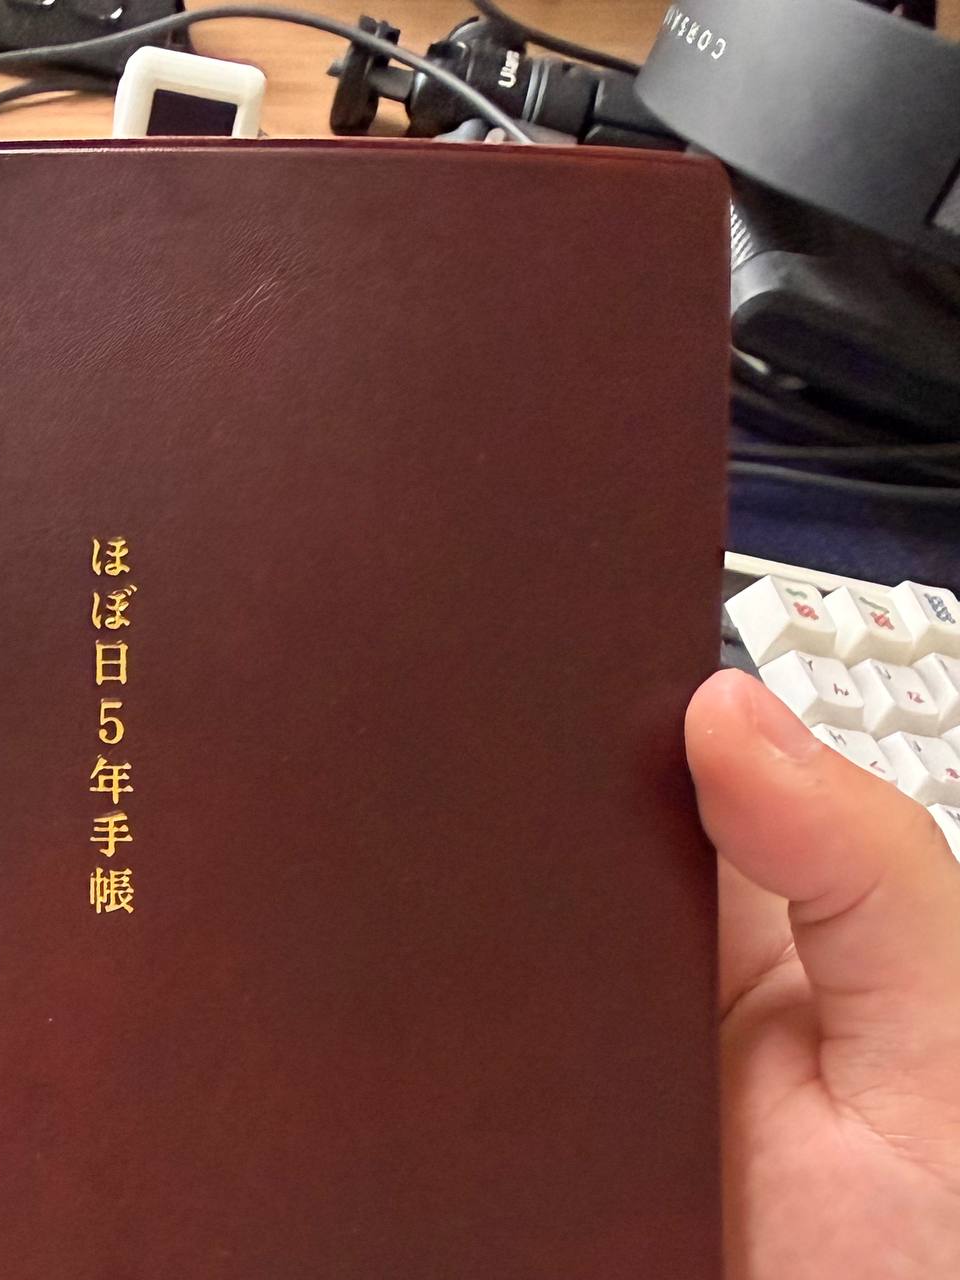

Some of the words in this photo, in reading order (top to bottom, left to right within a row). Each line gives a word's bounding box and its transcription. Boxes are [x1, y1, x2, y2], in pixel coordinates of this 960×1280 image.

[89, 535, 137, 915] ほぼ日5年手帳
